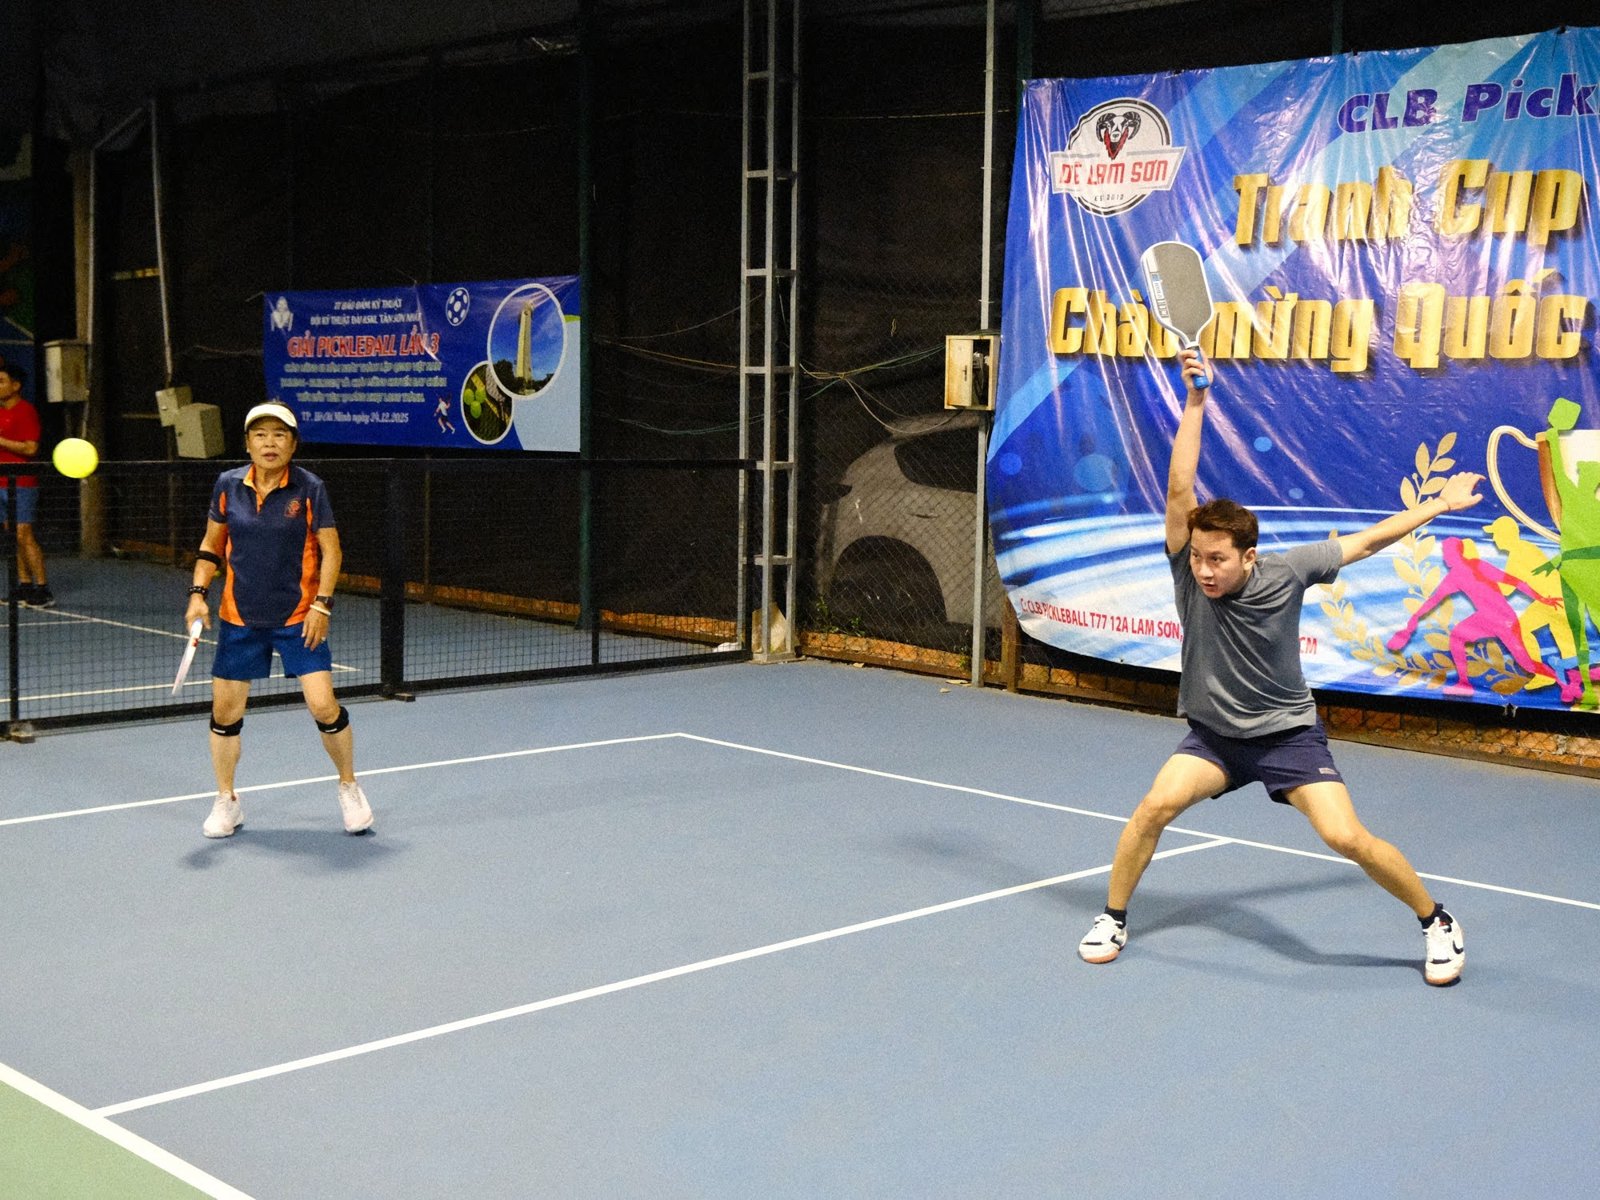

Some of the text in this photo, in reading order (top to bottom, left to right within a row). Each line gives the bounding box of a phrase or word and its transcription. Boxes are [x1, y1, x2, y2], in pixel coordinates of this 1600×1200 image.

[1337, 88, 1438, 133] CLB
[1130, 159, 1168, 182] SƠN
[1233, 158, 1583, 246] Tranh Cup
[1050, 267, 1588, 373] Chào mừng Quốc
[316, 334, 397, 358] PICKLEBALL
[429, 333, 441, 355] 3
[1027, 599, 1043, 615] CLB
[1042, 602, 1088, 628] PICKLEBALL
[1089, 611, 1108, 630] T77
[1110, 615, 1129, 633] 12A
[1131, 617, 1155, 637] LAM
